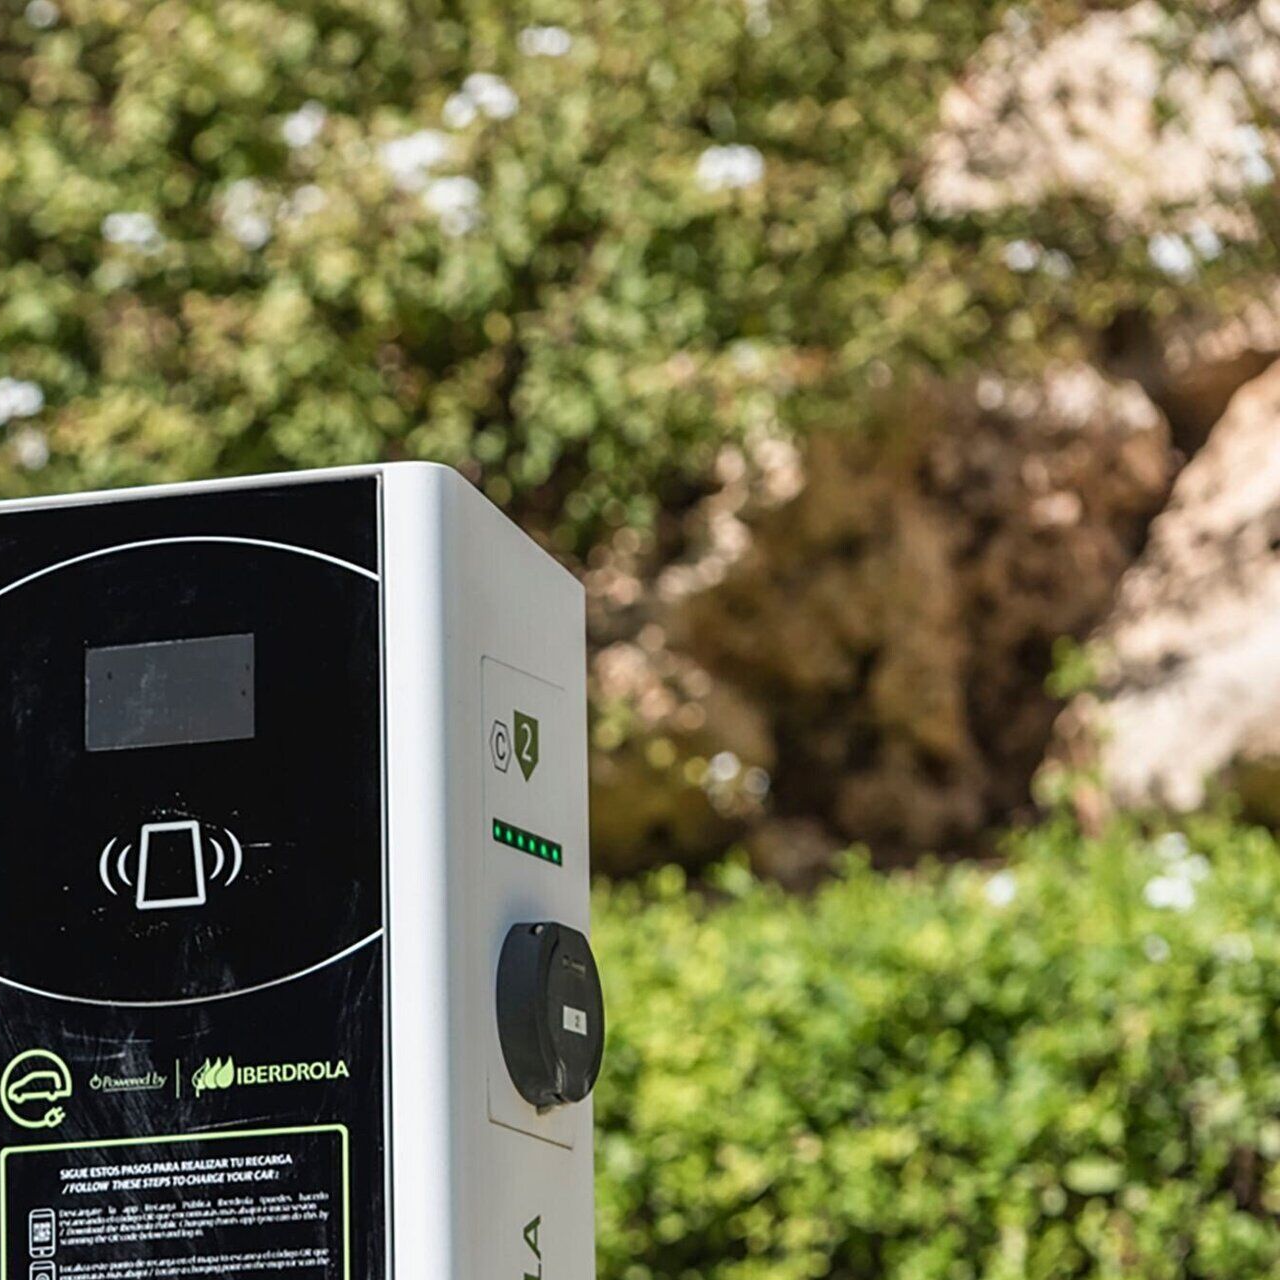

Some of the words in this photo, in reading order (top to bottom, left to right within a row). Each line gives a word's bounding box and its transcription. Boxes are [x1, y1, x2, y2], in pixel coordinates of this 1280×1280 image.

[521, 720, 533, 762] 2
[153, 1071, 168, 1088] by
[237, 1060, 349, 1085] IBERDROLA
[60, 1168, 88, 1179] SIGUE
[90, 1166, 119, 1177] ESTOS
[121, 1164, 151, 1175] PASOS
[153, 1162, 180, 1173] PARA
[181, 1159, 228, 1171] REALIZAR
[230, 1158, 243, 1168] TU
[245, 1154, 292, 1167] RECARGA
[112, 1178, 141, 1190] THESE
[143, 1176, 171, 1188] STEPS
[172, 1175, 185, 1186] TO
[186, 1173, 224, 1185] CHARGE
[226, 1171, 252, 1182] YOUR
